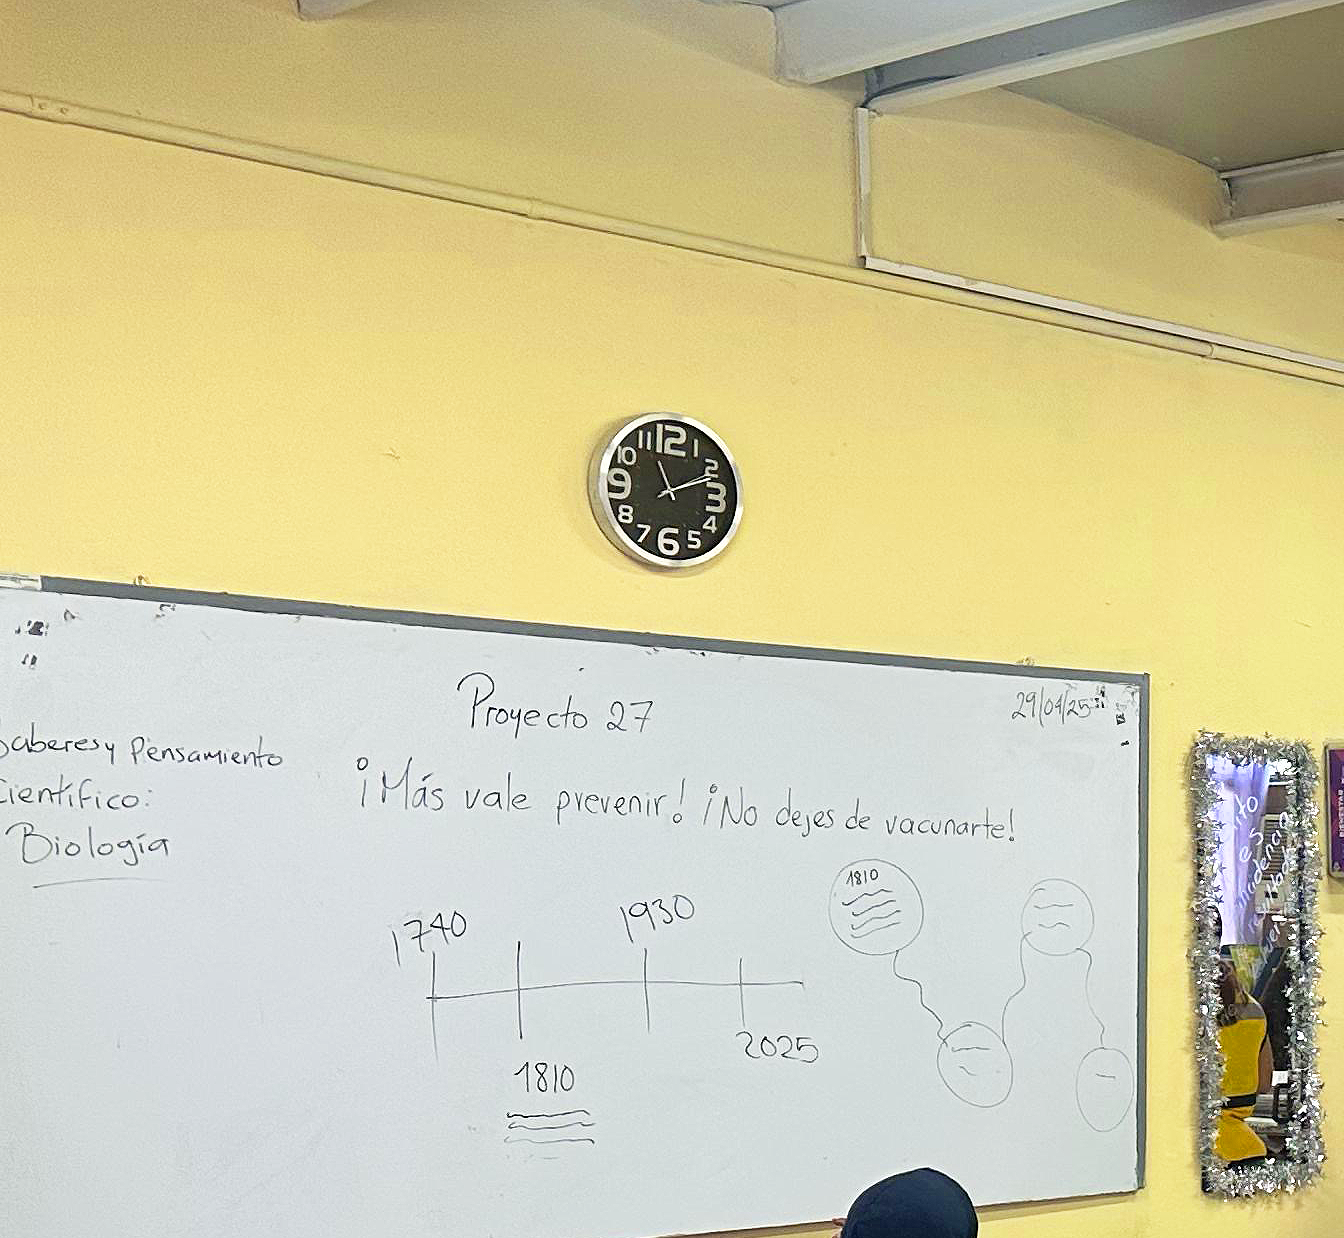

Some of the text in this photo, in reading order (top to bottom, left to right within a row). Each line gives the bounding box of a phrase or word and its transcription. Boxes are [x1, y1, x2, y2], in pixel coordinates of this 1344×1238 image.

[617, 446, 637, 465] 10
[638, 430, 652, 450] 11
[656, 423, 687, 457] 12
[693, 438, 699, 458] 1
[607, 468, 632, 500] 9
[704, 458, 719, 479] 2
[705, 482, 727, 513] 3
[617, 504, 634, 524] 8
[702, 515, 718, 533] 4
[637, 524, 651, 542] 7
[657, 527, 680, 556] 6
[687, 530, 701, 549] 5
[456, 672, 655, 738] Proyecto 27
[0, 721, 101, 757] aberes
[0, 770, 153, 808] ientífico:
[466, 771, 532, 813] vale
[555, 777, 687, 826] prevenir!
[702, 783, 759, 830] ¡No
[775, 787, 835, 838] dejes
[845, 797, 871, 831] de
[885, 806, 1016, 843] vacunarte!
[5, 822, 170, 867] Biología
[845, 868, 879, 886] 1810
[619, 894, 695, 943] 1930
[391, 910, 467, 967] 1740
[736, 1030, 819, 1064] 2025
[514, 1061, 575, 1094] 1810
